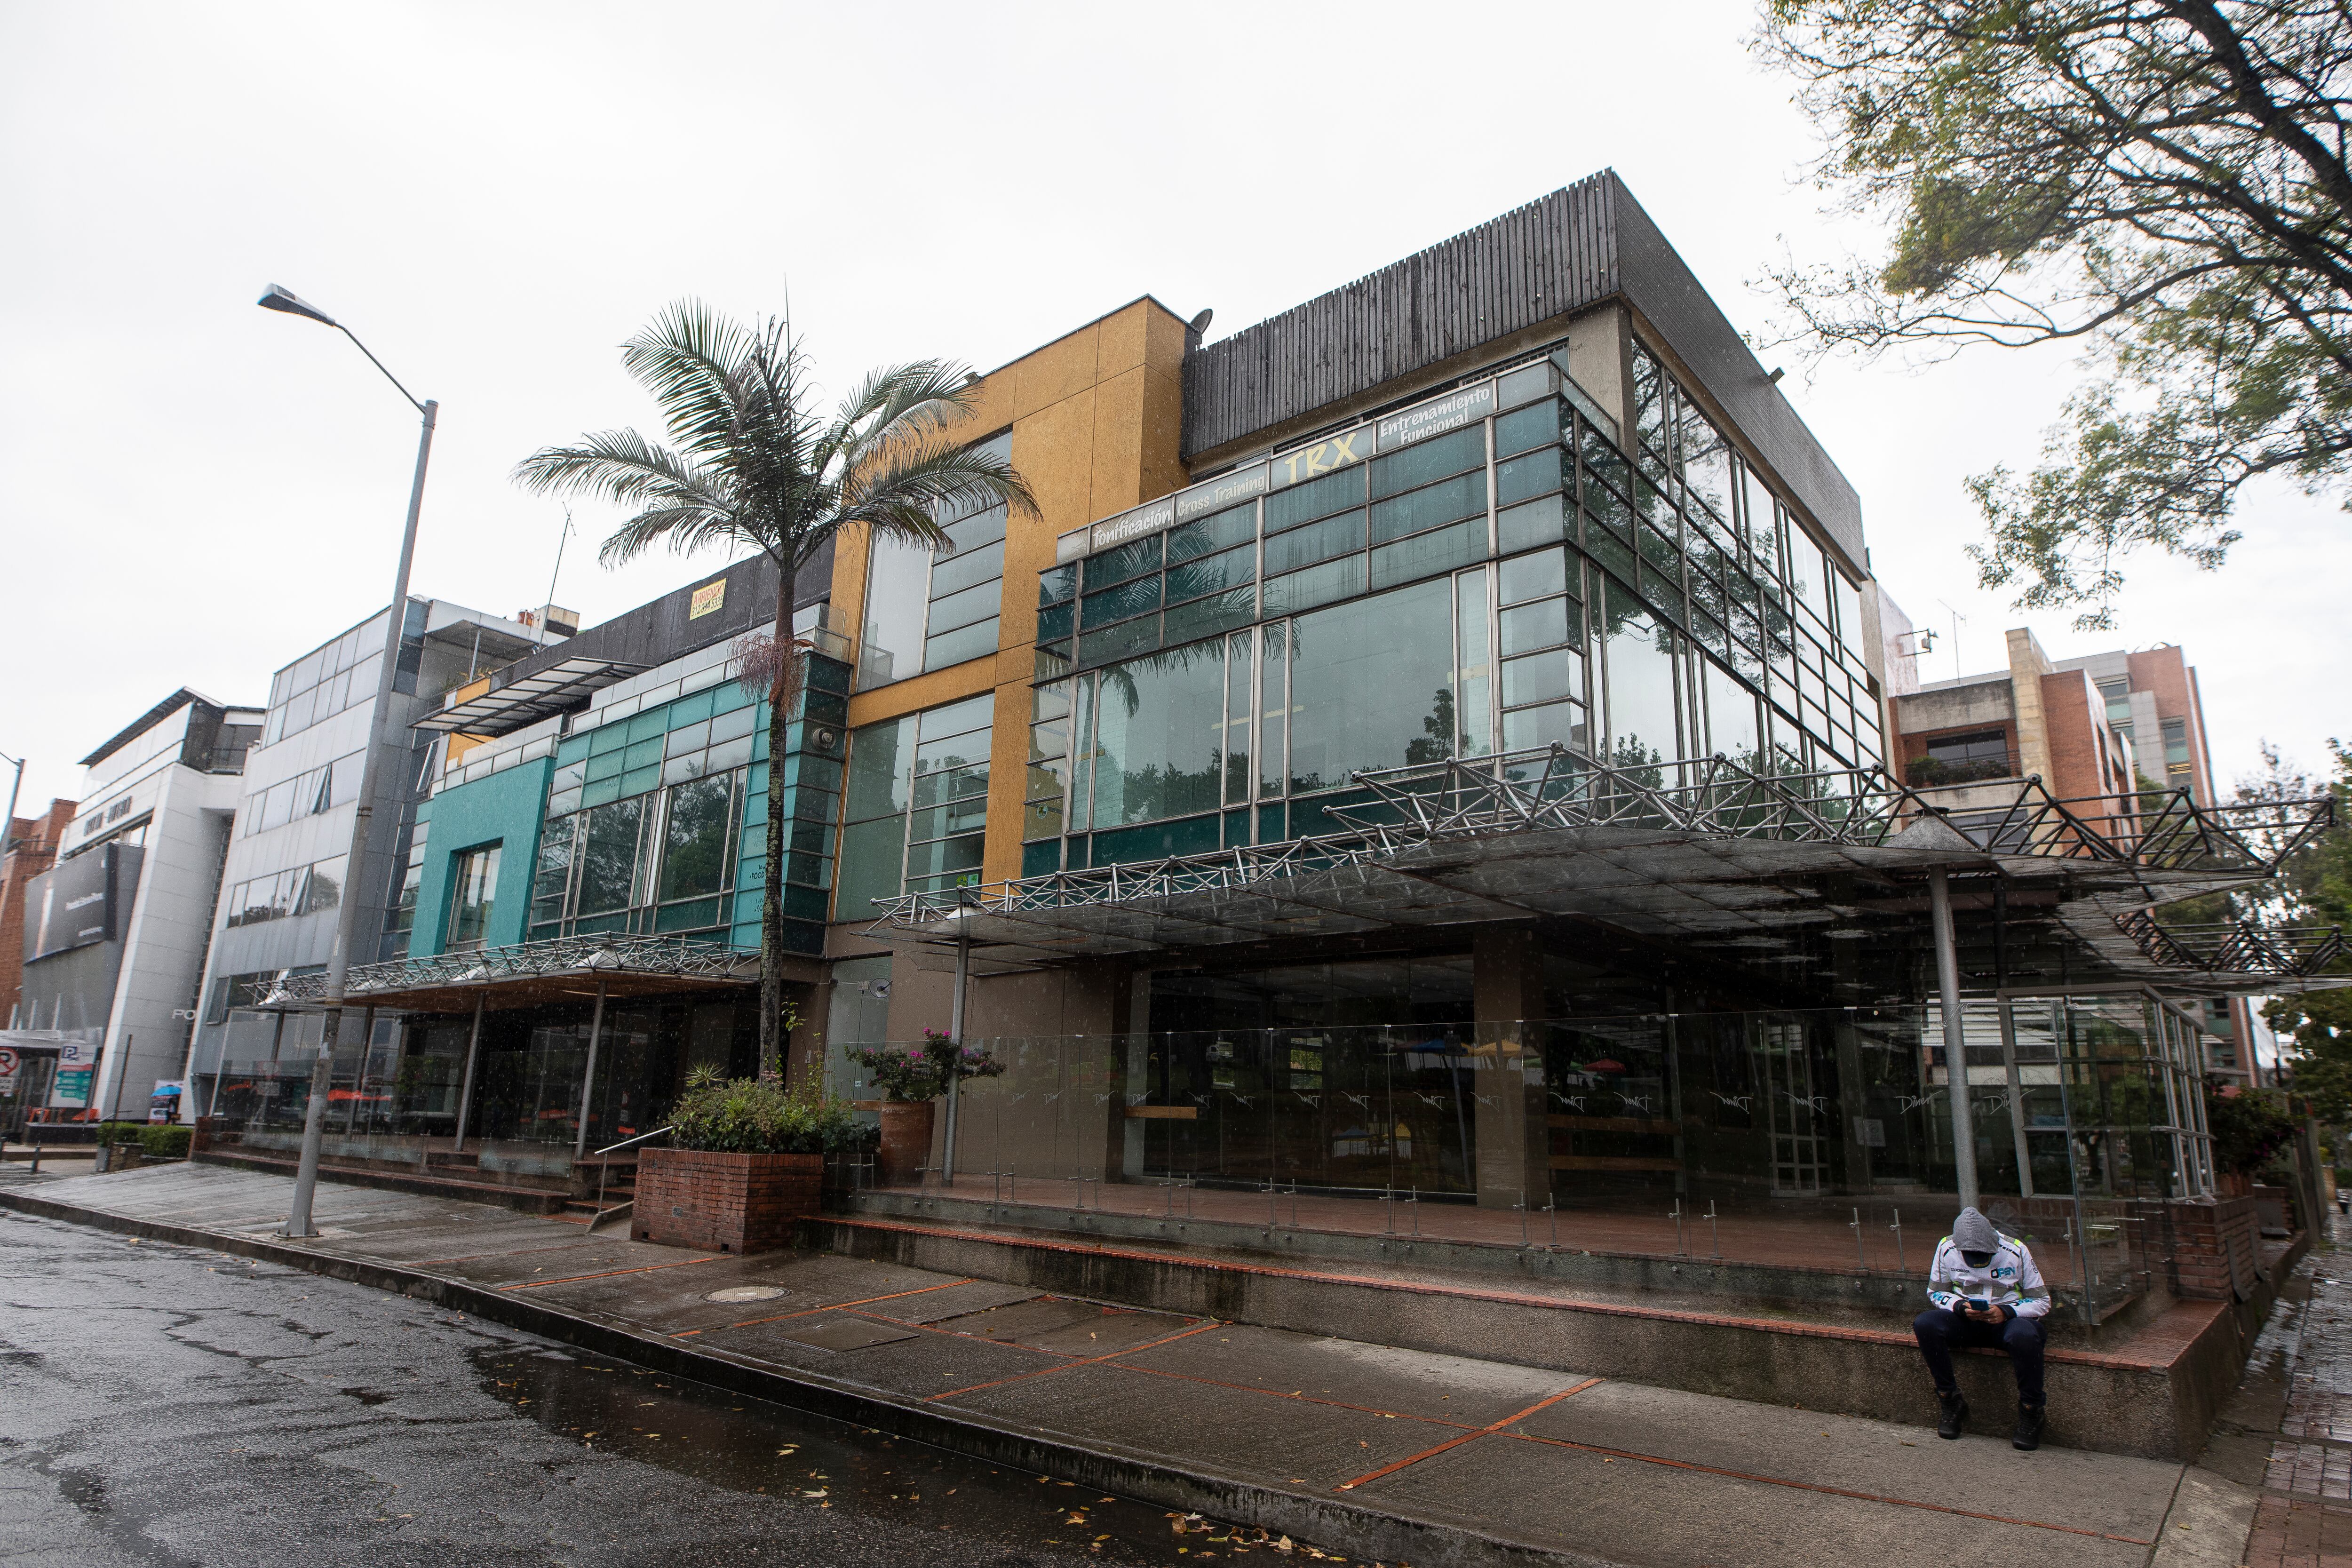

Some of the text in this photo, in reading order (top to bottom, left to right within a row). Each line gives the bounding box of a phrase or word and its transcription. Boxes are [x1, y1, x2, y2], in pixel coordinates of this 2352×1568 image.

[1380, 388, 1490, 438] Entrenamiento
[1401, 407, 1469, 445] Funcional
[1284, 432, 1359, 484] TRX
[1177, 474, 1265, 517] Cross Training
[1093, 508, 1171, 548] Tonificación
[691, 605, 700, 617] 312
[693, 582, 724, 606] ARRIENDO
[1894, 1090, 1944, 1114] Diner
[1991, 1266, 2016, 1279] OPEN
